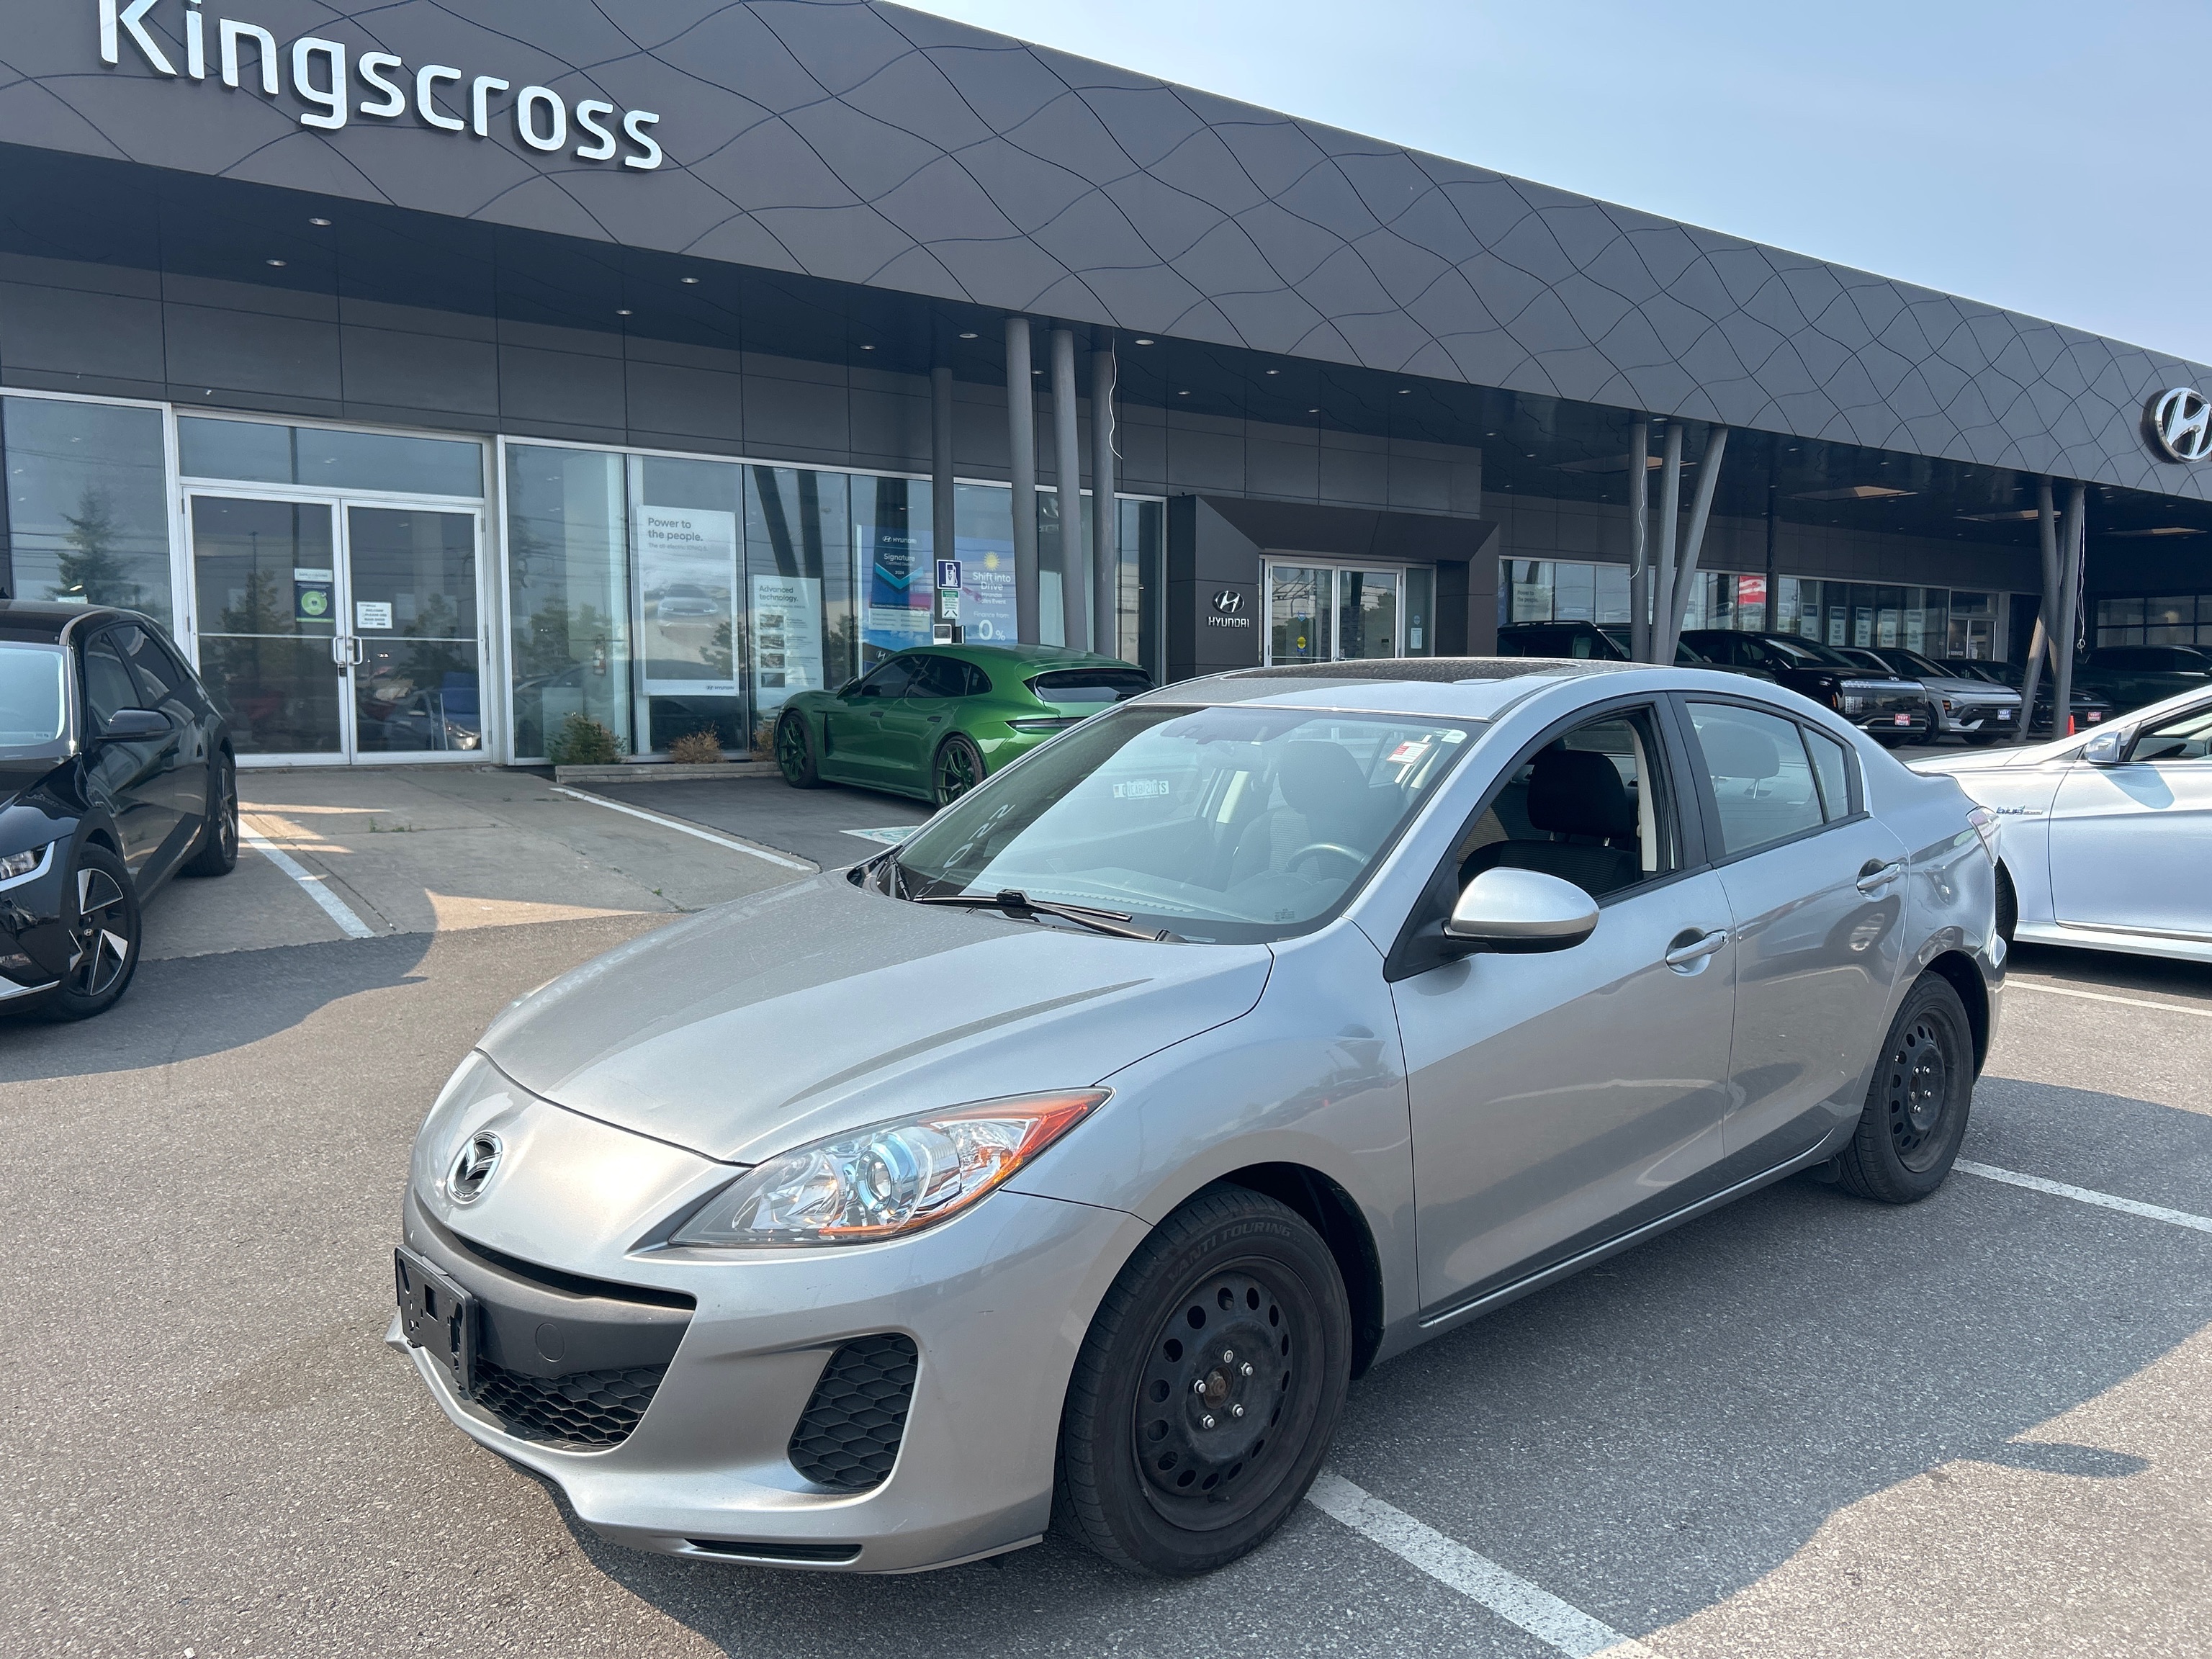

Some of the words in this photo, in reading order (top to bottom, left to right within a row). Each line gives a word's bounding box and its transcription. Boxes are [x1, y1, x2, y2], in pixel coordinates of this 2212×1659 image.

[99, 0, 662, 170] Kingscross
[647, 517, 679, 528] Power
[681, 520, 691, 529] to
[647, 529, 665, 539] the
[667, 531, 703, 542] people.
[884, 553, 916, 562] Signature
[973, 572, 993, 582] Shift
[994, 573, 1012, 583] into
[759, 585, 793, 594] Advanced
[981, 582, 1004, 590] Drive
[1208, 616, 1250, 628] HYUNDAI
[979, 619, 994, 641] 0
[995, 630, 1006, 641] %
[1168, 1236, 1218, 1282] VANTI
[1221, 1221, 1292, 1241] TOURING
